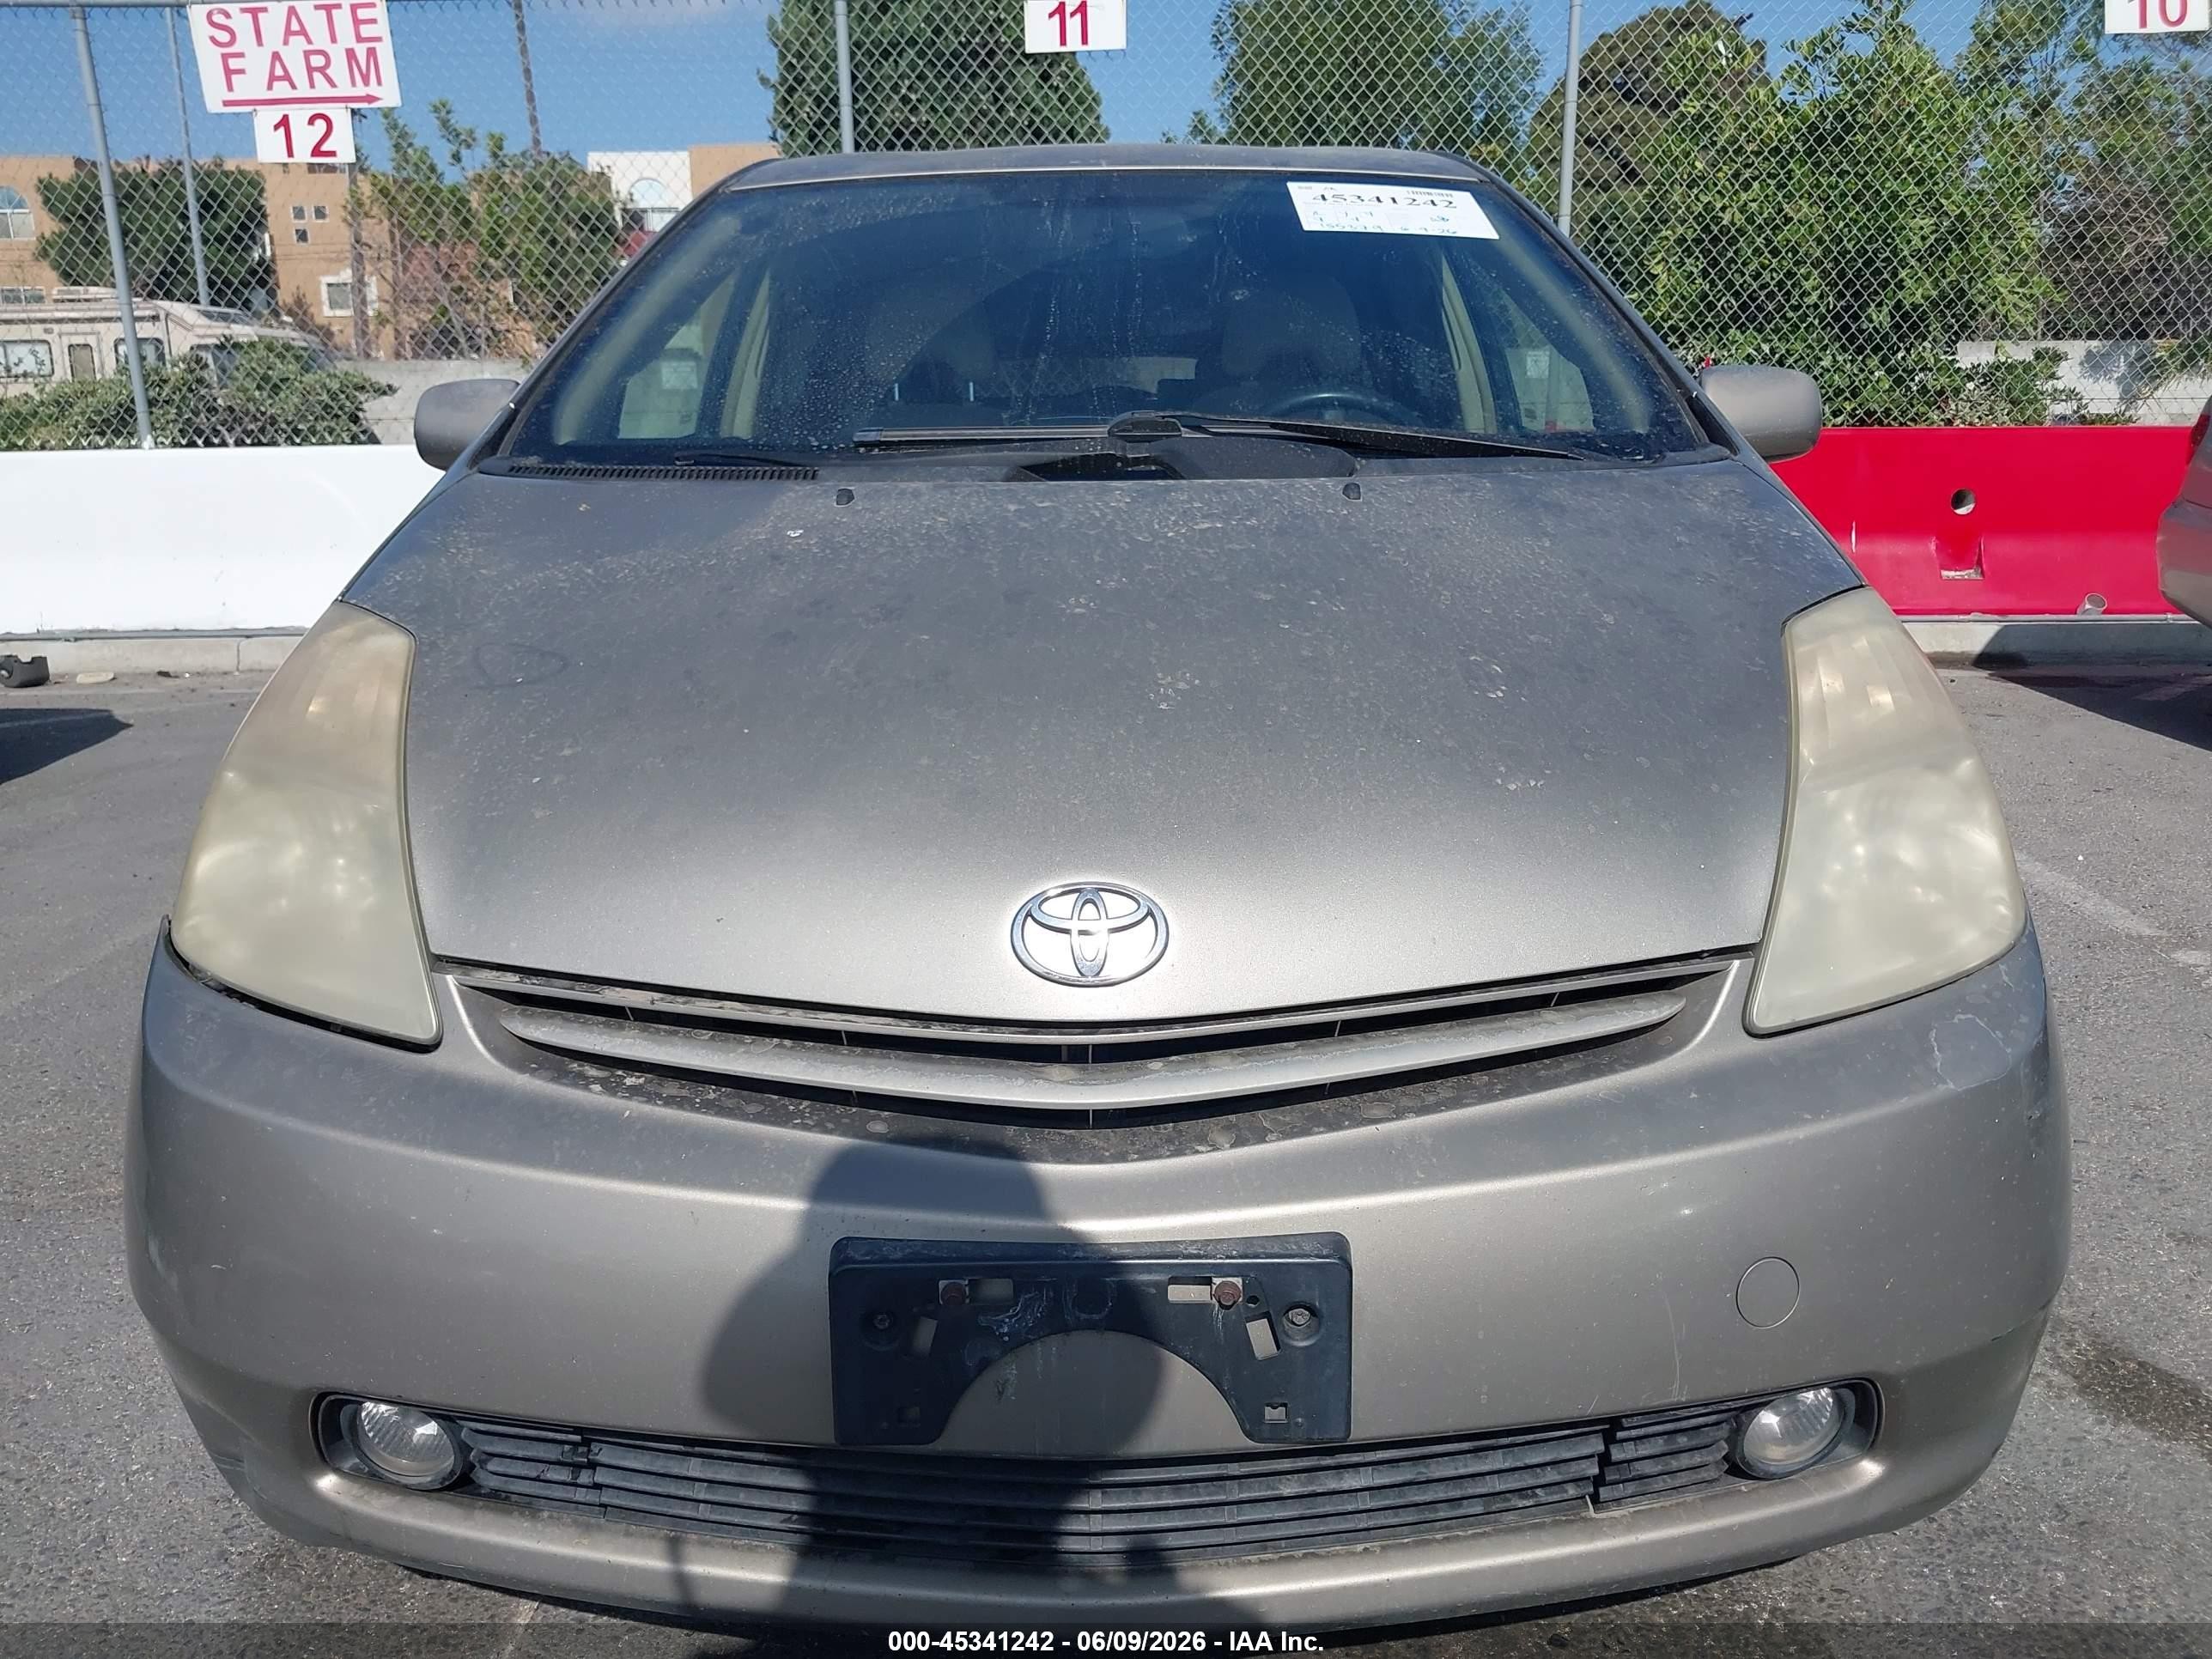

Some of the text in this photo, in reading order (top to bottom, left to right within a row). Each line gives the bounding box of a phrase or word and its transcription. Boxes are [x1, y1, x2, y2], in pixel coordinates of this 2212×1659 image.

[205, 2, 383, 48] STATE
[1048, 0, 1089, 46] 11
[220, 46, 383, 93] FARM
[273, 112, 337, 159] 12
[1312, 192, 1457, 210] 45341242
